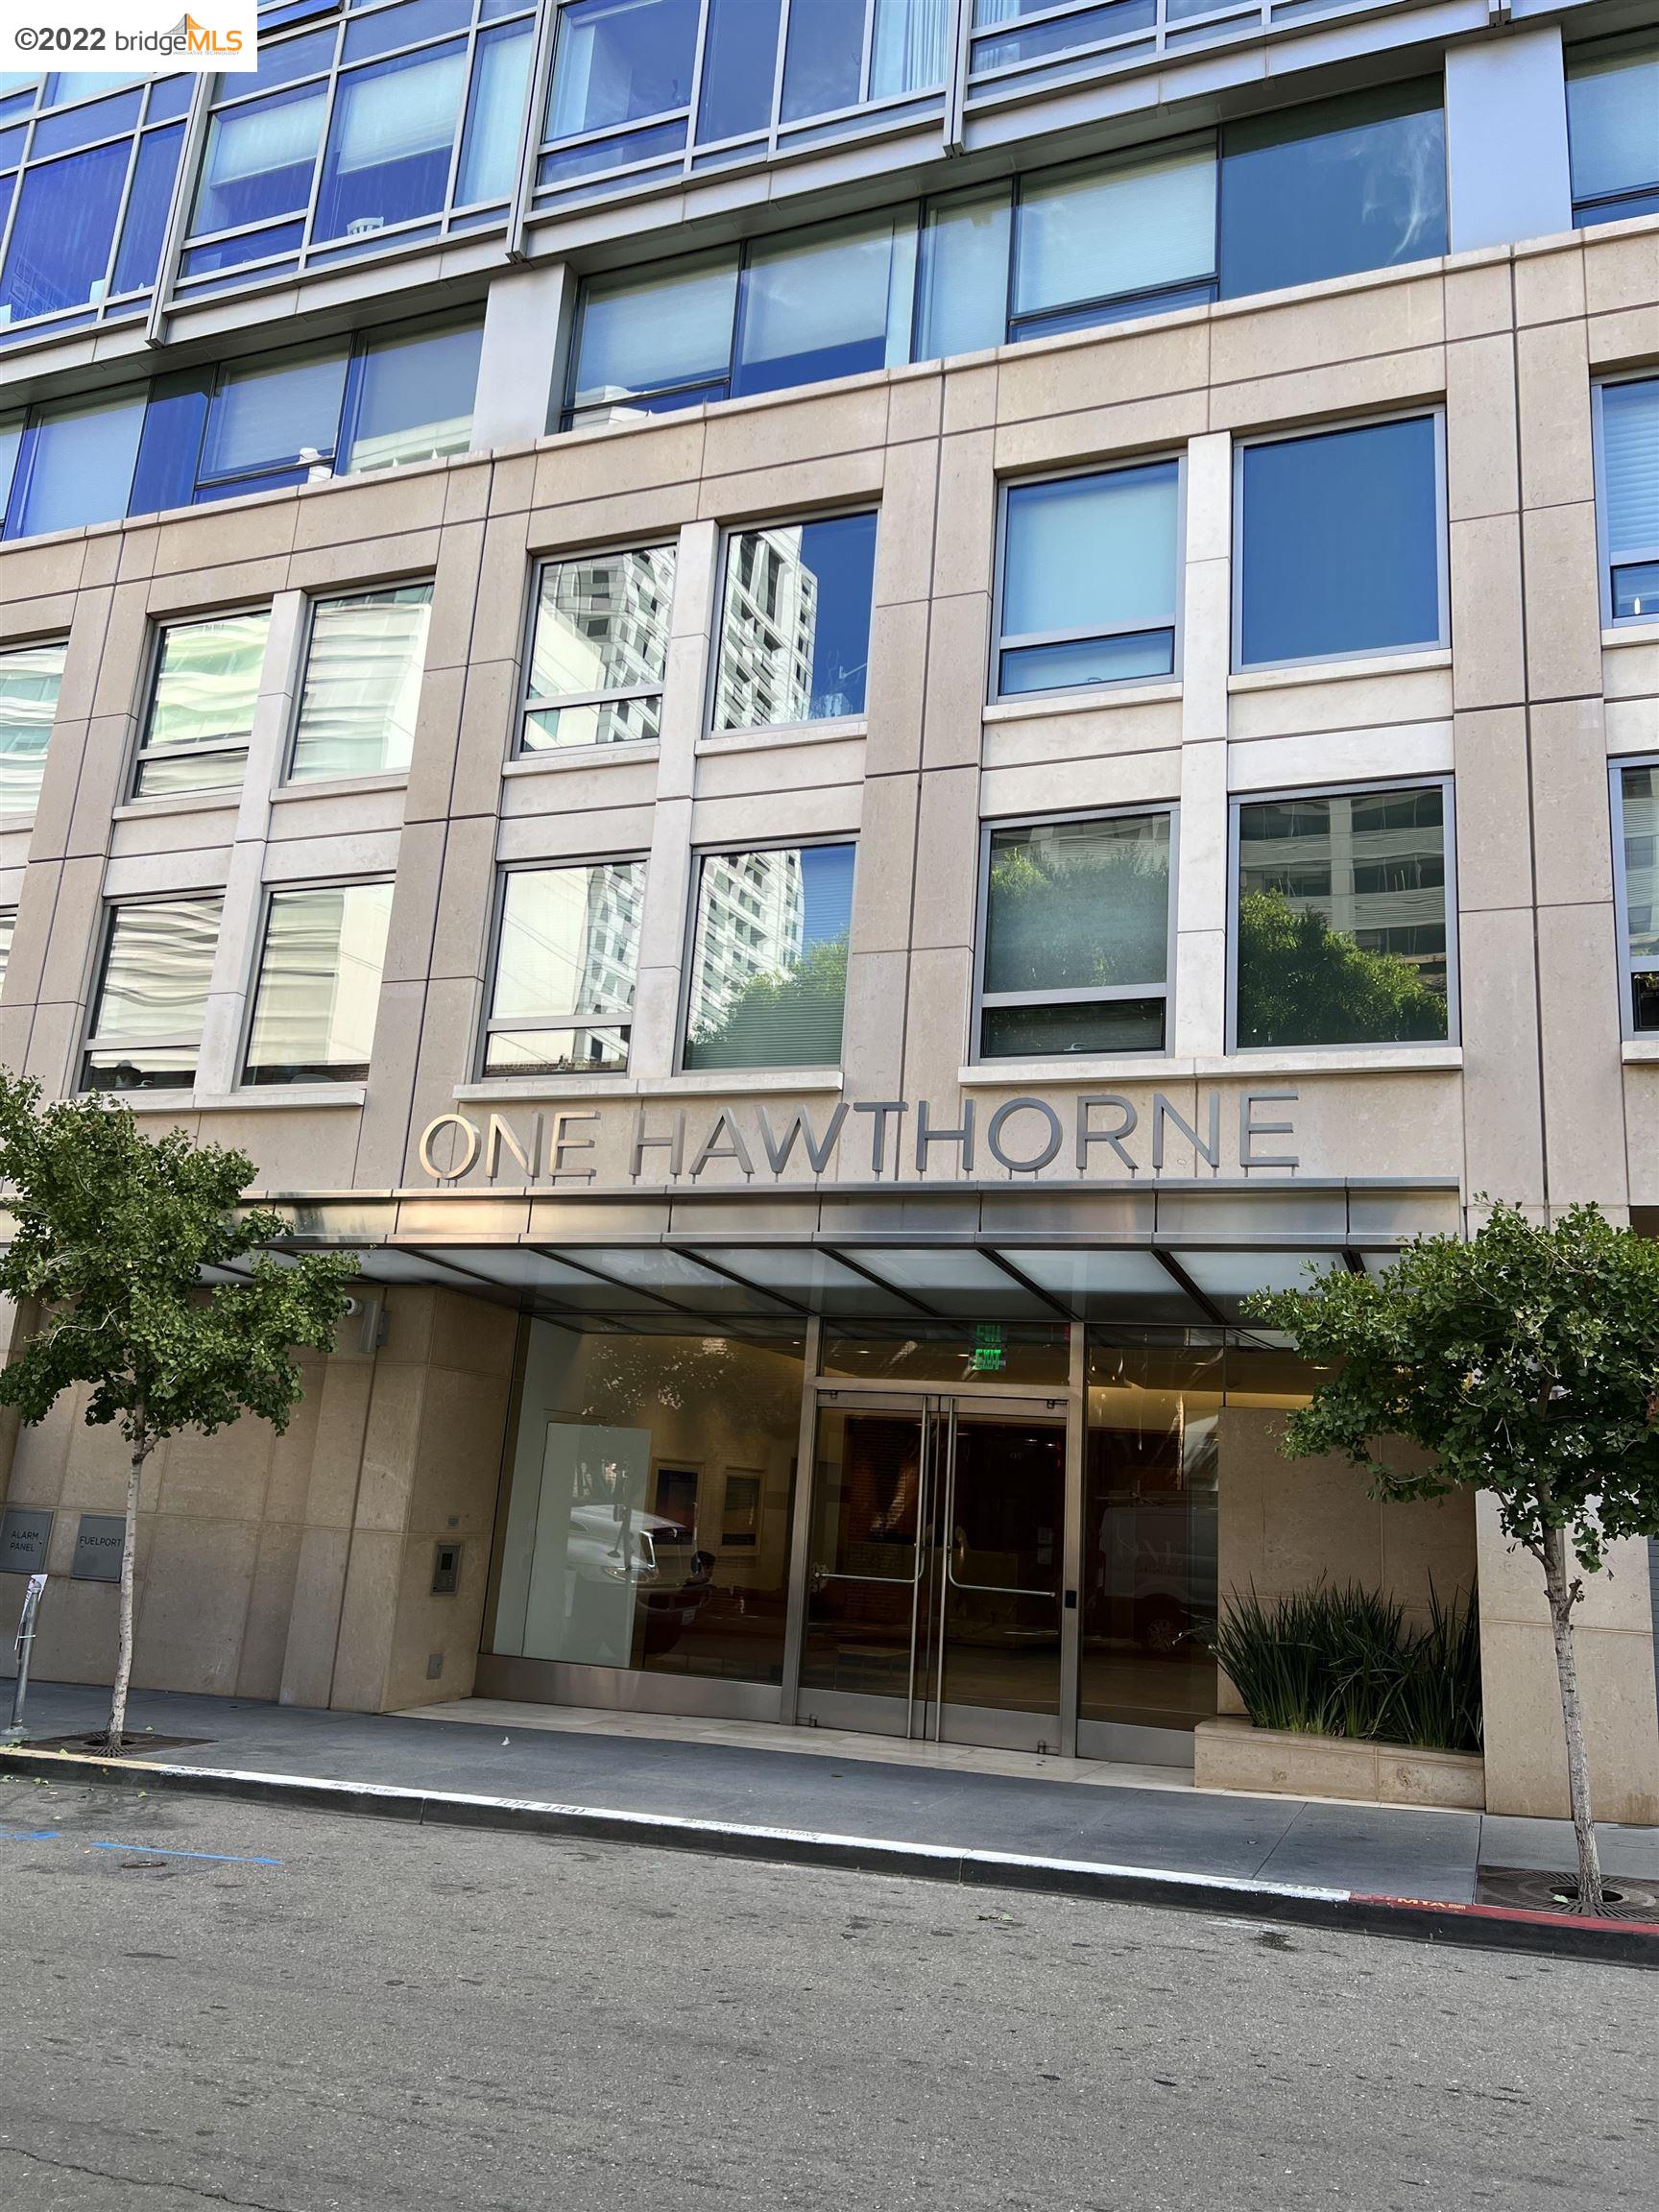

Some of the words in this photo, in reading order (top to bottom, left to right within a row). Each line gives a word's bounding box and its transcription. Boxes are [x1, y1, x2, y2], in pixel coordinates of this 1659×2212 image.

[420, 1111, 602, 1183] ONE
[631, 1090, 1299, 1183] HAWTHORNE
[11, 1530, 39, 1540] ALARM
[10, 1542, 36, 1552] PANEL
[79, 1536, 122, 1548] FUELPORT
